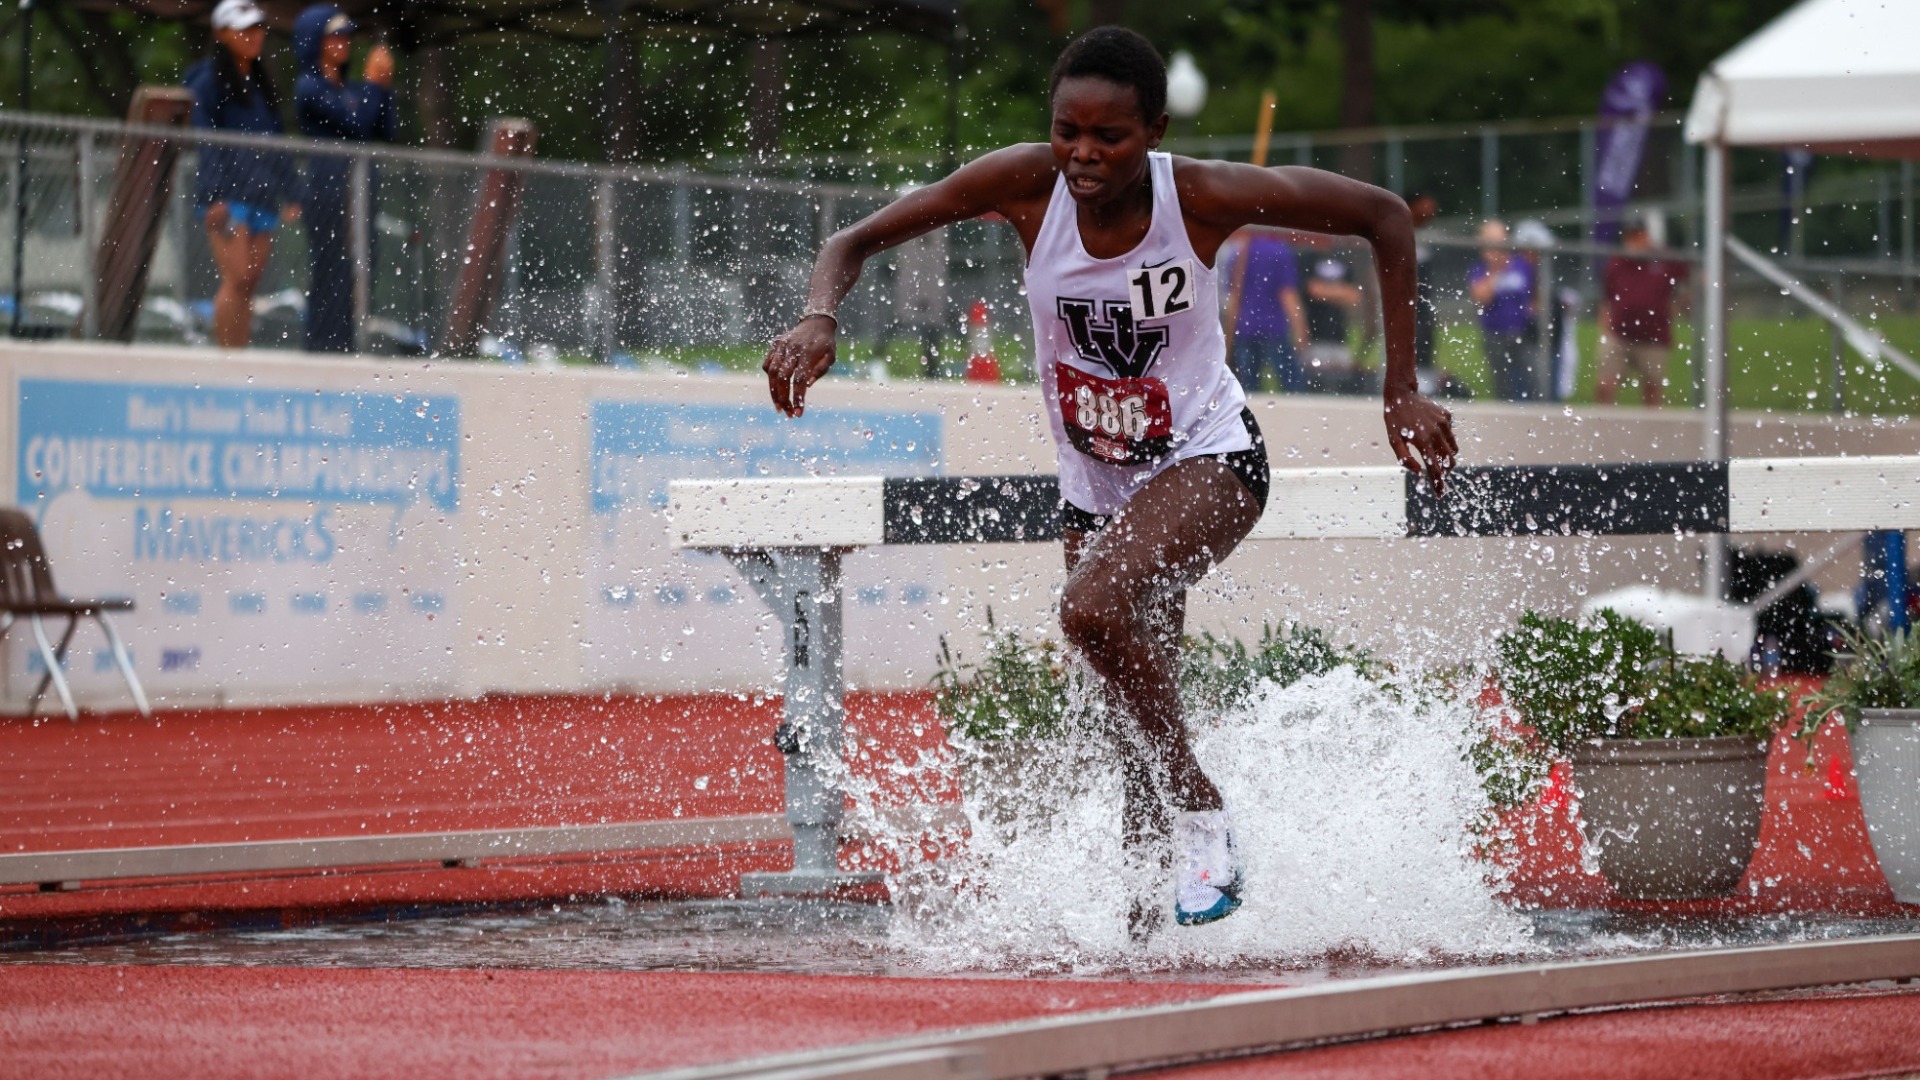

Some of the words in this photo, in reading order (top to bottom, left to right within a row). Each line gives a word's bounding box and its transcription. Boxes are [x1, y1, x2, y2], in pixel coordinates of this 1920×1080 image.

[1132, 266, 1190, 318] 12
[1074, 385, 1149, 440] 886
[25, 434, 213, 489] CONFERENCE
